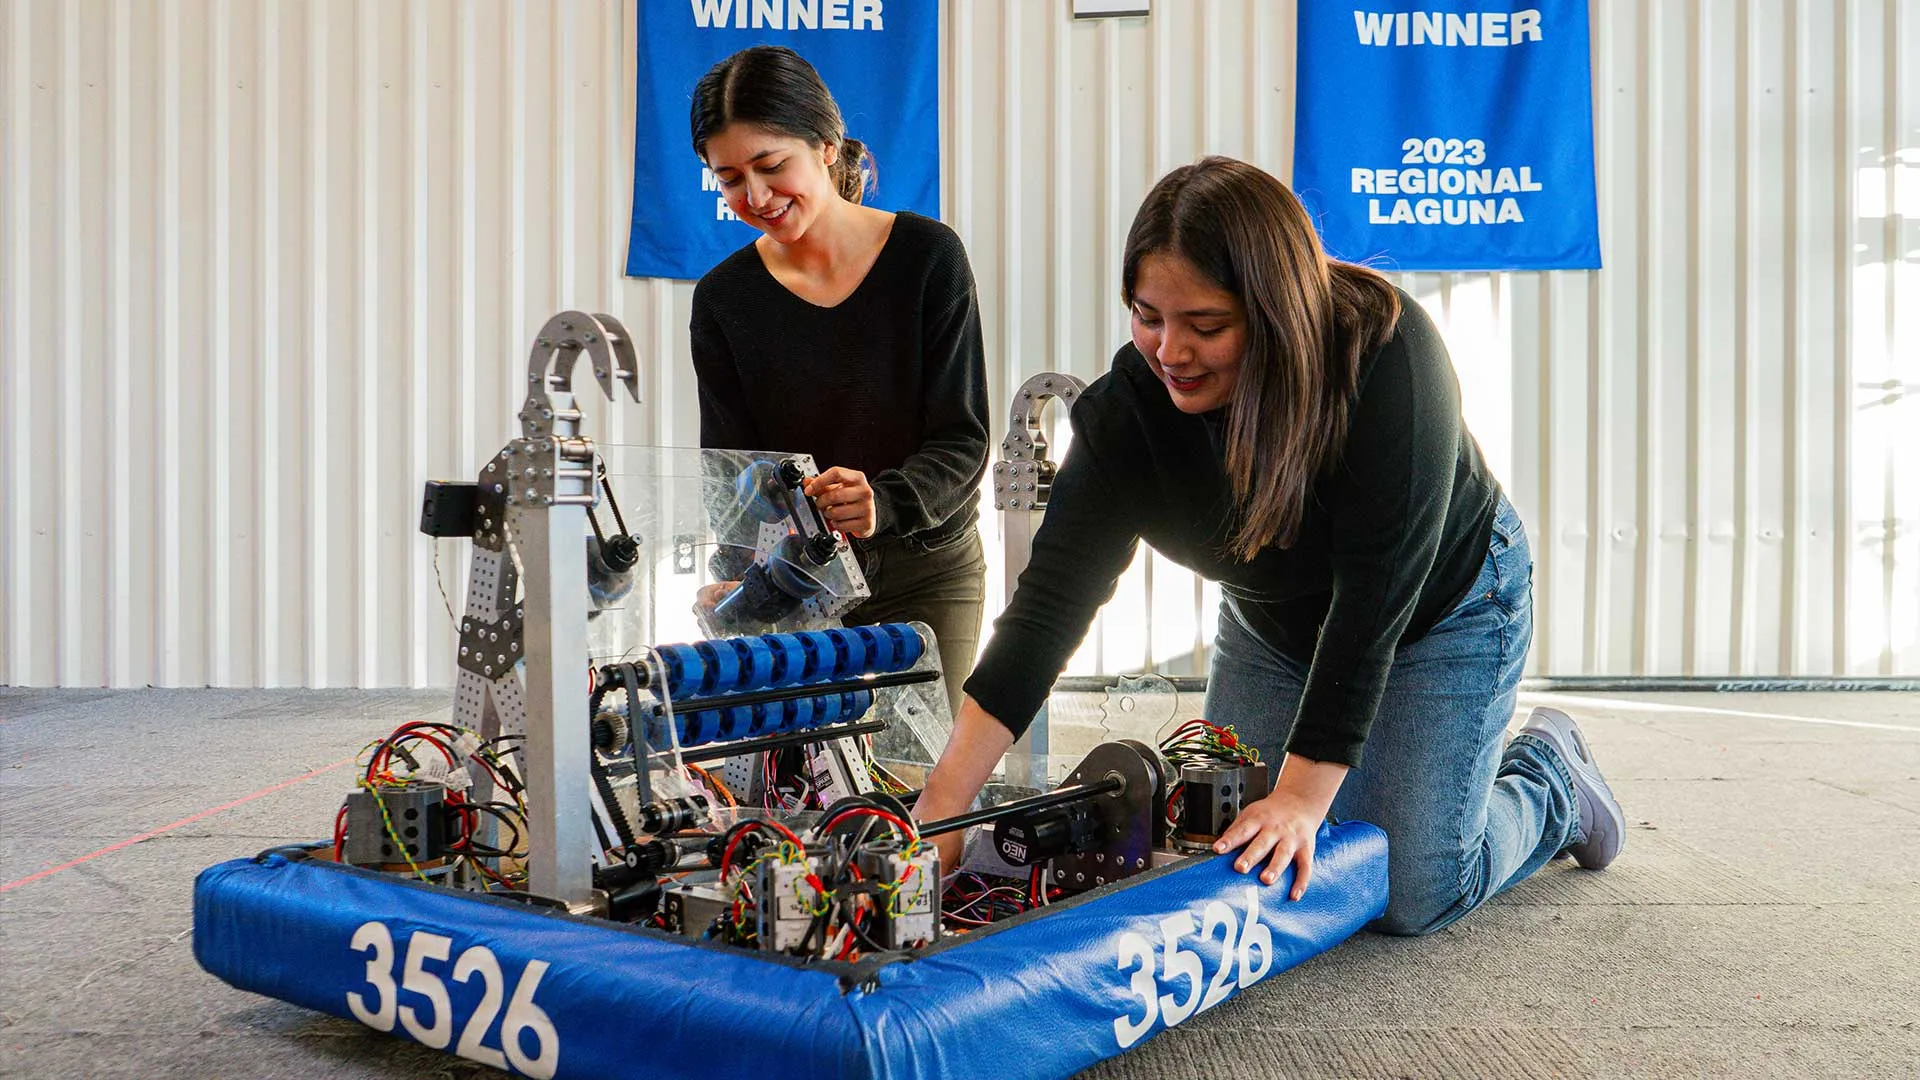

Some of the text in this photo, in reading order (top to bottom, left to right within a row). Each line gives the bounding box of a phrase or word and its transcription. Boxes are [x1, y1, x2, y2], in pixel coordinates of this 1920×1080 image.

[690, 0, 884, 31] WINNER
[1354, 9, 1543, 47] WINNER
[1402, 137, 1486, 166] 2023
[1351, 166, 1542, 195] REGIONAL
[1369, 198, 1524, 225] LAGUNA
[1002, 841, 1027, 860] NEO
[1113, 885, 1273, 1049] 3526
[346, 921, 560, 1080] 3526
